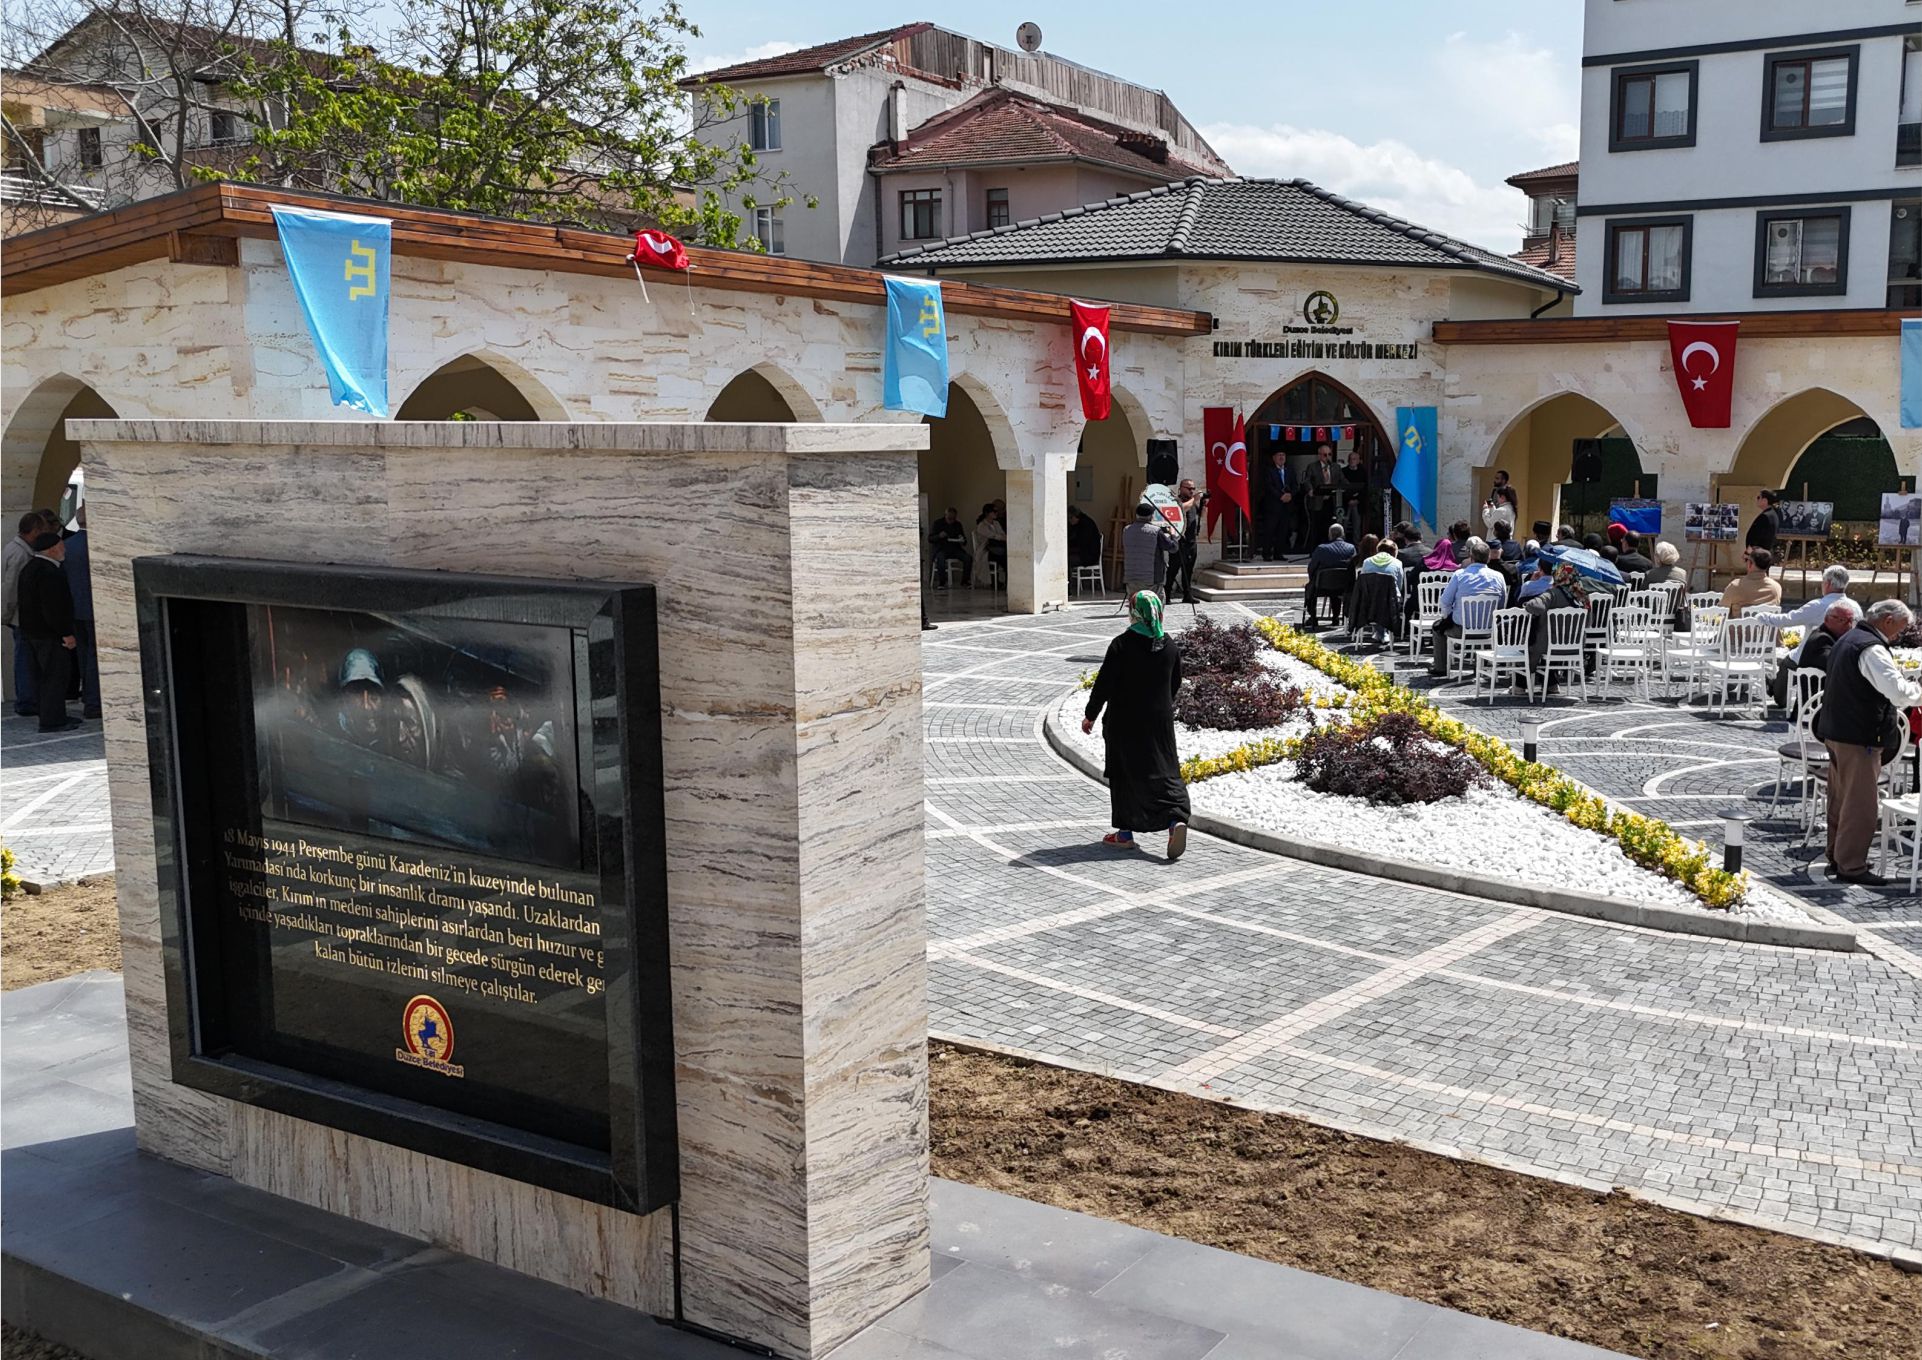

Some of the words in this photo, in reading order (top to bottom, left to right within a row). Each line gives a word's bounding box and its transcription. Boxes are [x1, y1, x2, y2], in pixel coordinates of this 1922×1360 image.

[1213, 341, 1242, 358] KIRIM
[1244, 338, 1289, 359] TÜRKLERİ
[1290, 339, 1323, 359] EĞİTİM
[1325, 343, 1337, 360] VE
[1339, 340, 1373, 360] KÜLTÜR
[1375, 341, 1418, 360] MERKEZİ
[224, 828, 234, 842] 18
[237, 828, 269, 851] Mayıs
[272, 840, 296, 858] 1944
[299, 839, 354, 864] Perşembe
[356, 851, 386, 870] günü
[390, 855, 466, 885] Karadeniz'in
[469, 868, 536, 896] kuzeyinde
[538, 880, 595, 907] bulunan
[224, 851, 307, 881] Yarımadası'nda
[309, 865, 357, 893] korkunç
[359, 874, 376, 893] bir
[378, 879, 426, 903] insanlık
[428, 887, 465, 910] dramı
[467, 899, 520, 920] yaşandı.
[523, 904, 600, 936] Uzaklardan
[228, 876, 279, 902] işgalciler,
[282, 885, 327, 909] Kırım'ın
[329, 898, 373, 918] medeni
[375, 905, 439, 931] sahiplerini
[441, 919, 504, 944] asırlardan
[507, 927, 533, 950] beri
[537, 933, 577, 958] huzur
[579, 947, 594, 962] ve
[239, 902, 272, 923] içinde
[274, 913, 333, 936] yaşadıkları
[336, 924, 423, 954] topraklarından
[426, 938, 444, 958] bir
[446, 947, 489, 967] gecede
[491, 953, 536, 978] sürgün
[538, 963, 584, 987] ederek
[314, 941, 346, 963] kalan
[348, 947, 385, 971] bütün
[387, 956, 428, 980] izlerini
[431, 966, 478, 994] silmeye
[480, 978, 538, 1004] çalıştılar.
[423, 1057, 464, 1076] Belediyesi
